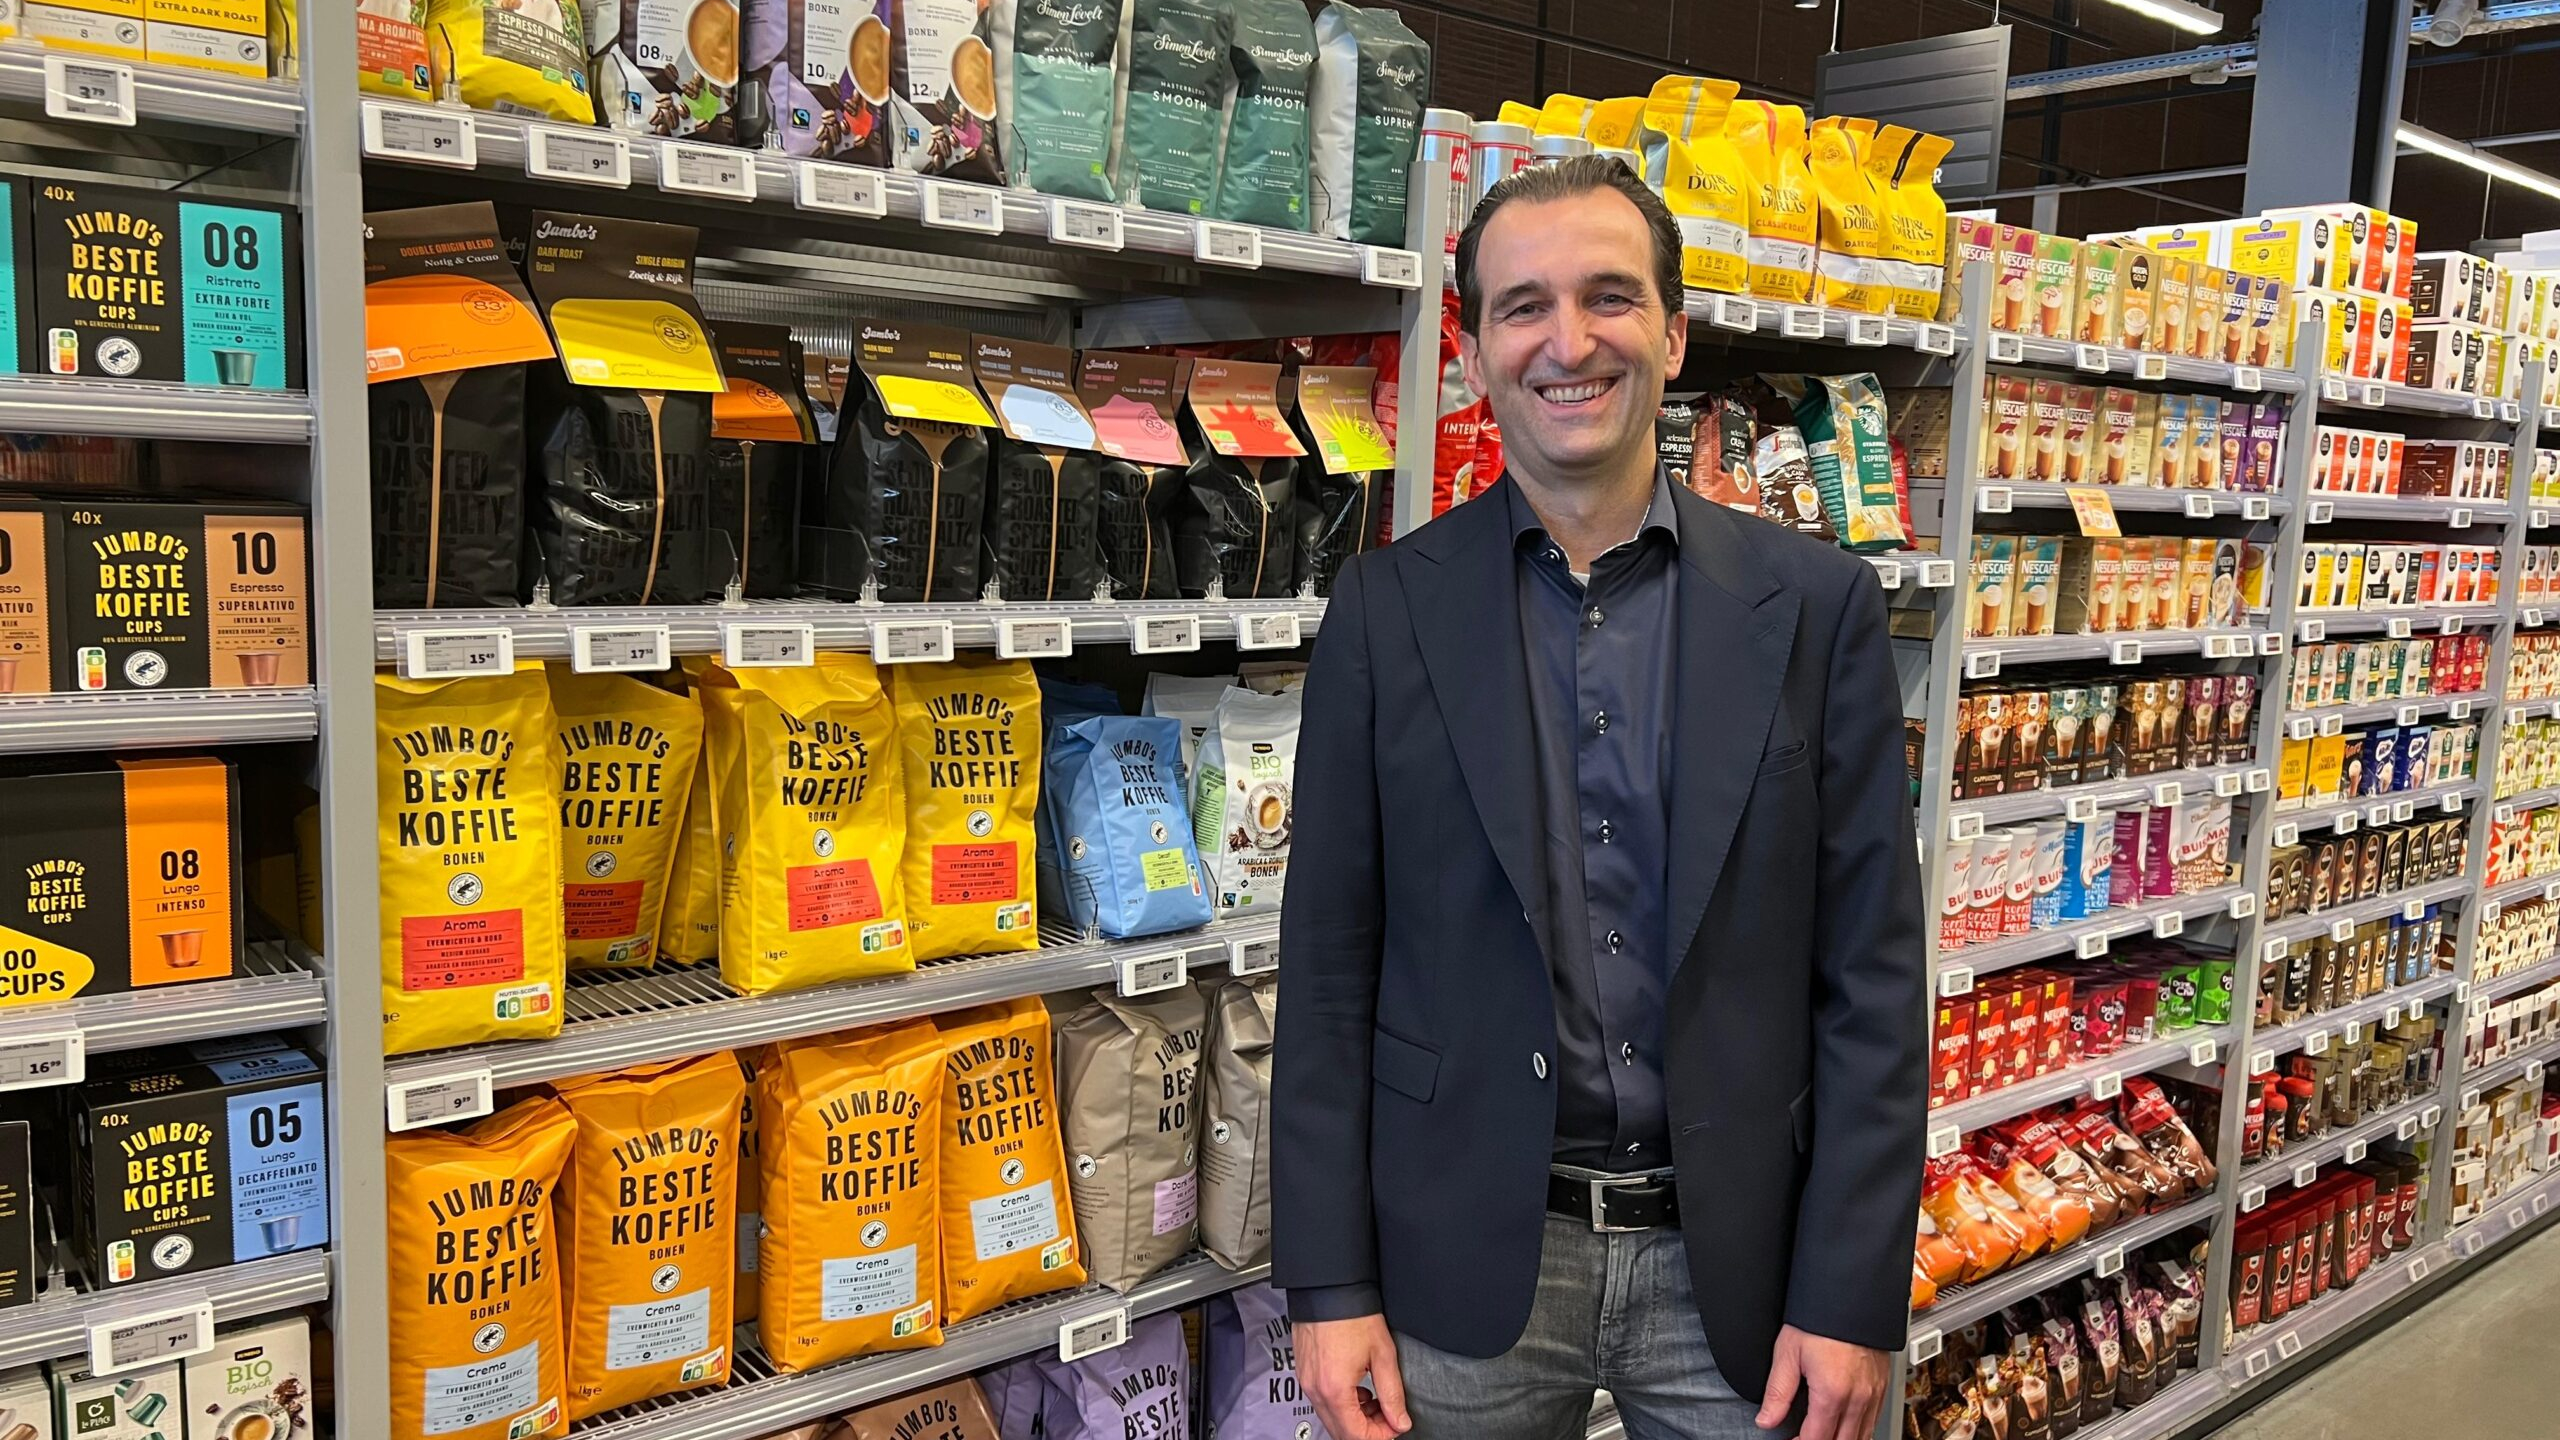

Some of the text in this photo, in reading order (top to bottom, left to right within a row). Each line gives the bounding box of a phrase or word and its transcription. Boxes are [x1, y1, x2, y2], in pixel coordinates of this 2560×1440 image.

[153, 1, 258, 24] EXTRA DARK ROAST
[809, 3, 840, 14] BONEN
[1037, 0, 1070, 20] Simon
[498, 12, 544, 36] ESPRESSO
[81, 29, 88, 39] 8
[909, 28, 938, 37] BONEN
[205, 47, 212, 56] 8
[1154, 34, 1190, 54] Simon
[1251, 45, 1284, 58] Simon
[1161, 81, 1205, 96] MASTERBLEND
[1152, 91, 1207, 111] SMOOTH
[1453, 152, 1470, 179] illy
[44, 186, 75, 202] 40x
[1756, 220, 1807, 233] CLASSIC ROAST
[204, 222, 258, 270] 08
[400, 239, 494, 257] DOUBLE ORIGIN BLEND
[1845, 240, 1864, 249] DARK
[72, 244, 158, 276] BESTE
[467, 254, 499, 263] Cacao
[537, 246, 583, 260] DARK ROAST
[536, 262, 555, 273] Brasil
[636, 254, 685, 269] SINGLE ORIGIN
[206, 275, 260, 290] Ristretto
[628, 270, 684, 284] Zoetig & Rijk
[68, 273, 164, 306] KOFFIE
[196, 294, 270, 310] EXTRA FORTE
[99, 305, 136, 320] CUPS
[1660, 443, 1692, 453] ESPRESSO
[72, 512, 101, 525] 40x
[232, 532, 276, 575] 10
[100, 564, 184, 589] BESTE
[230, 583, 284, 594] Espresso
[96, 592, 190, 617] KOFFIE
[218, 600, 295, 611] SUPERLATIVO
[126, 620, 162, 634] CUPS
[935, 729, 1014, 756] BESTE
[789, 740, 868, 771] BESTE
[1250, 756, 1281, 770] BIO
[565, 763, 661, 793] BESTE
[930, 760, 1020, 788] KOFFIE
[1121, 764, 1157, 783] BESTE
[404, 768, 506, 803] BESTE
[782, 775, 867, 807] KOFFIE
[963, 794, 995, 804] BONEN
[1123, 787, 1168, 807] KOFFIE
[808, 811, 837, 822] BONEN
[399, 808, 517, 847] KOFFIE
[587, 835, 623, 845] BONEN
[444, 851, 484, 866] BONEN
[963, 848, 994, 857] Aroma
[160, 849, 199, 881] 08
[814, 867, 845, 878] Aroma
[1251, 866, 1278, 878] BONEN
[30, 878, 82, 896] BESTE
[163, 884, 200, 895] Lungo
[577, 888, 613, 897] Aroma
[28, 894, 86, 913] KOFFIE
[156, 899, 205, 913] INTENSO
[44, 912, 72, 924] CUPS
[444, 919, 487, 932] Aroma
[499, 987, 539, 998] NUTRI-SCORE
[510, 1000, 519, 1013] B
[957, 1066, 1036, 1111] BESTE
[100, 1114, 129, 1128] 40x
[250, 1102, 302, 1148] 05
[957, 1098, 1044, 1147] KOFFIE
[827, 1125, 915, 1166] BESTE
[994, 1139, 1024, 1156] BONEN
[261, 1152, 296, 1164] Lungo
[127, 1148, 208, 1185] BESTE
[238, 1162, 317, 1186] DECAFFEINATO
[619, 1162, 713, 1208] BESTE
[822, 1158, 920, 1202] KOFFIE
[124, 1174, 214, 1212] KOFFIE
[1000, 1193, 1030, 1208] Crema
[153, 1205, 188, 1223] CUPS
[857, 1201, 891, 1216] BONEN
[612, 1198, 715, 1246] KOFFIE
[436, 1213, 538, 1265] BESTE
[649, 1244, 685, 1261] BONEN
[856, 1257, 889, 1271] Crema
[428, 1248, 542, 1305] KOFFIE
[470, 1300, 510, 1321] BONEN
[646, 1303, 681, 1317] Crema
[226, 1360, 273, 1385] BIO
[467, 1361, 507, 1379] Crema
